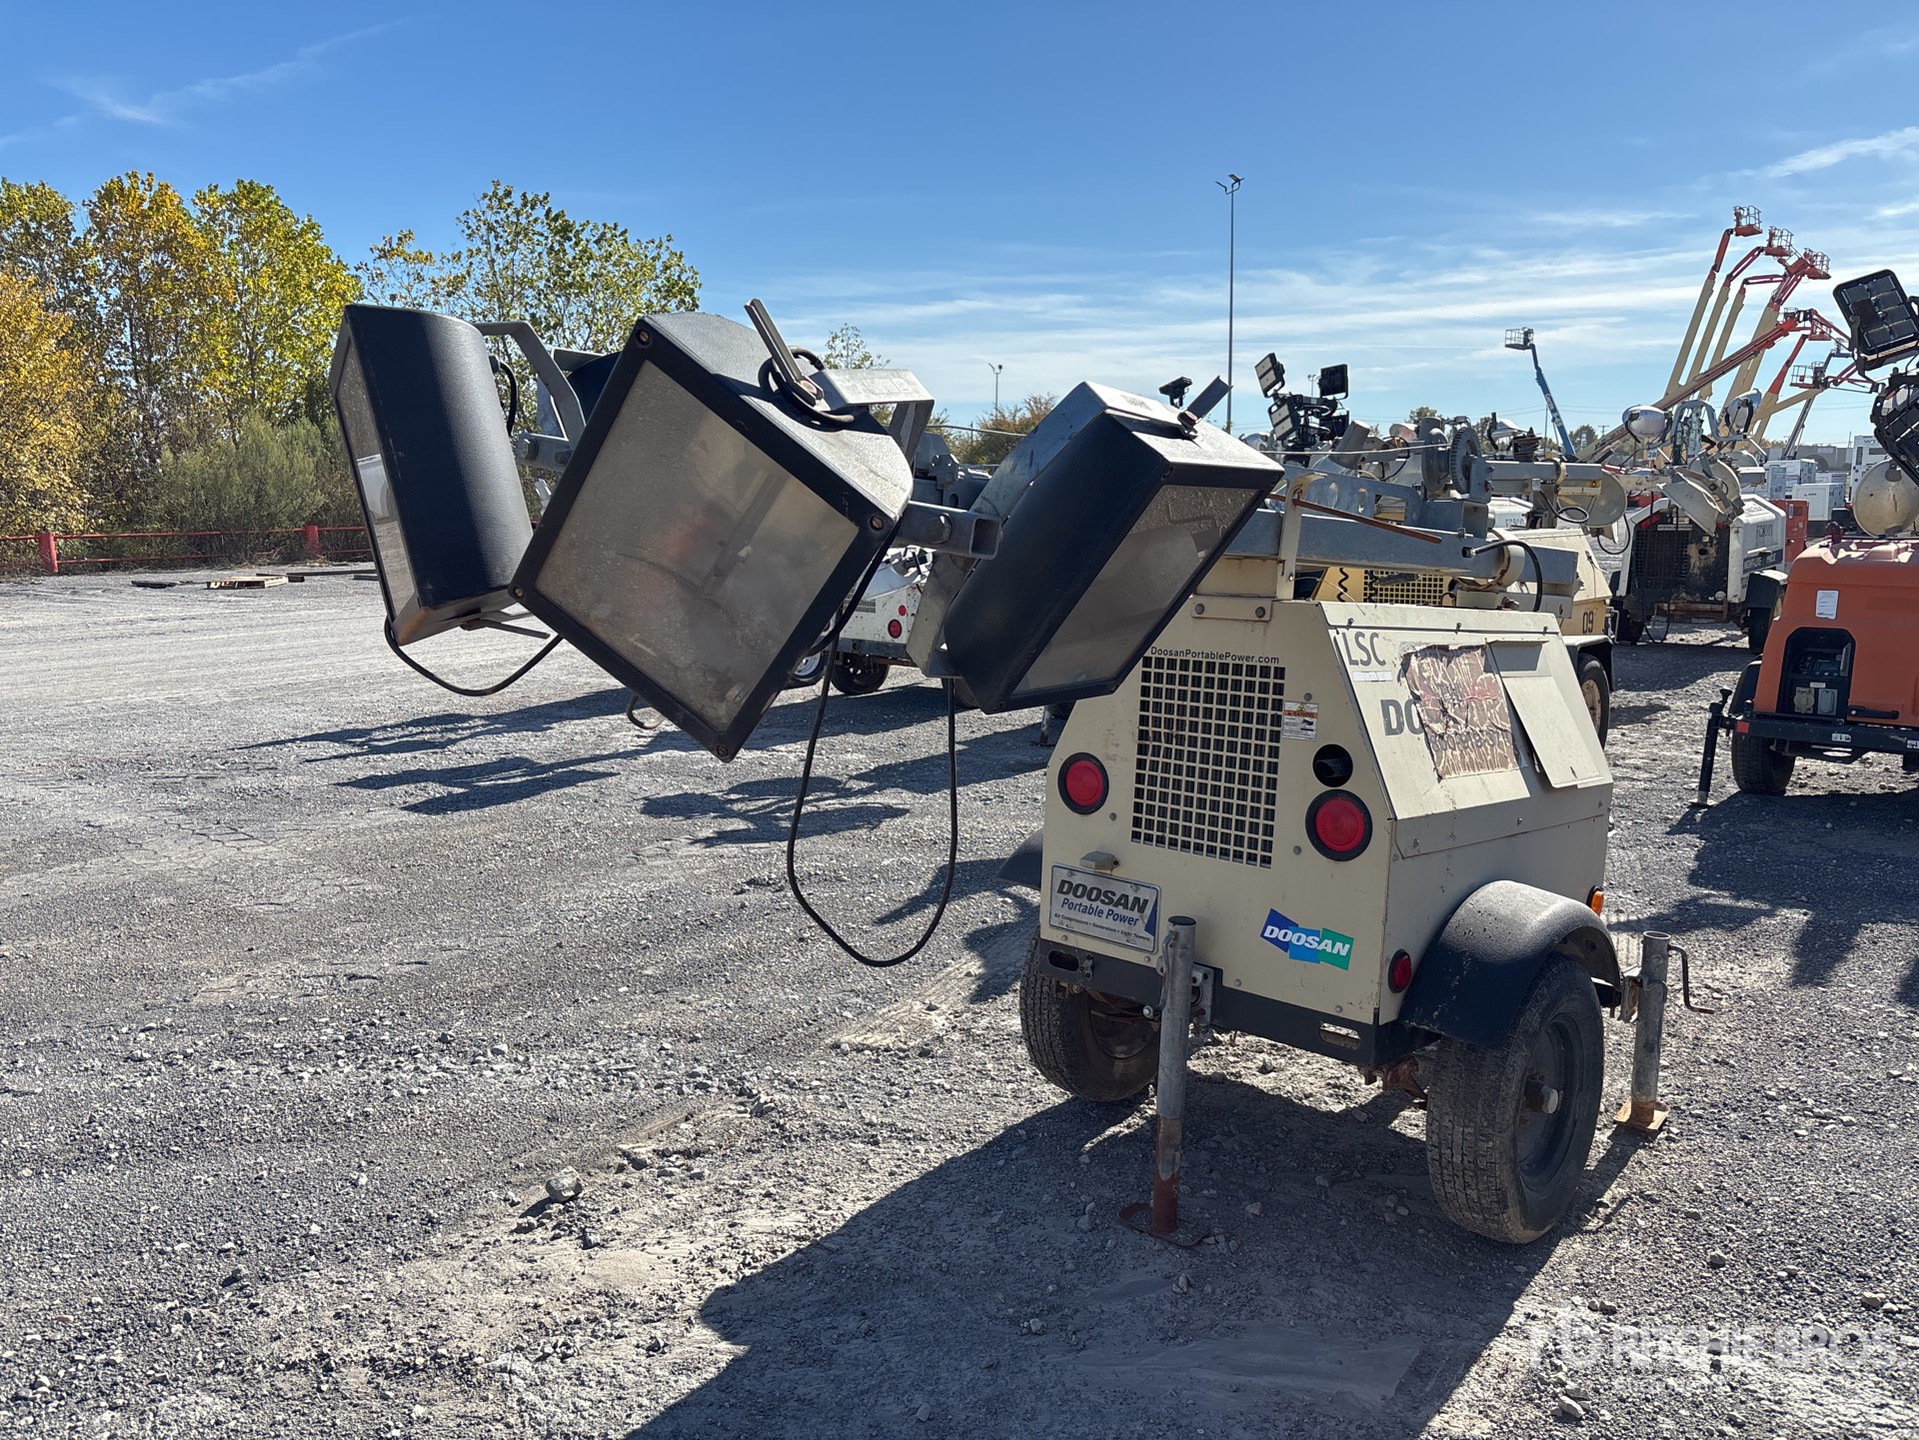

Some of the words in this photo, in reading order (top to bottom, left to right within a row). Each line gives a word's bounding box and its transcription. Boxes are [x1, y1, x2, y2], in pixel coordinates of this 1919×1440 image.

[1151, 646, 1279, 664] DoosanPortablePower.com
[1343, 631, 1386, 667] LSC
[1057, 879, 1149, 914] DOOSAN
[1061, 898, 1104, 919] Portable
[1105, 909, 1140, 927] Power
[1263, 925, 1351, 957] DOOSAN
